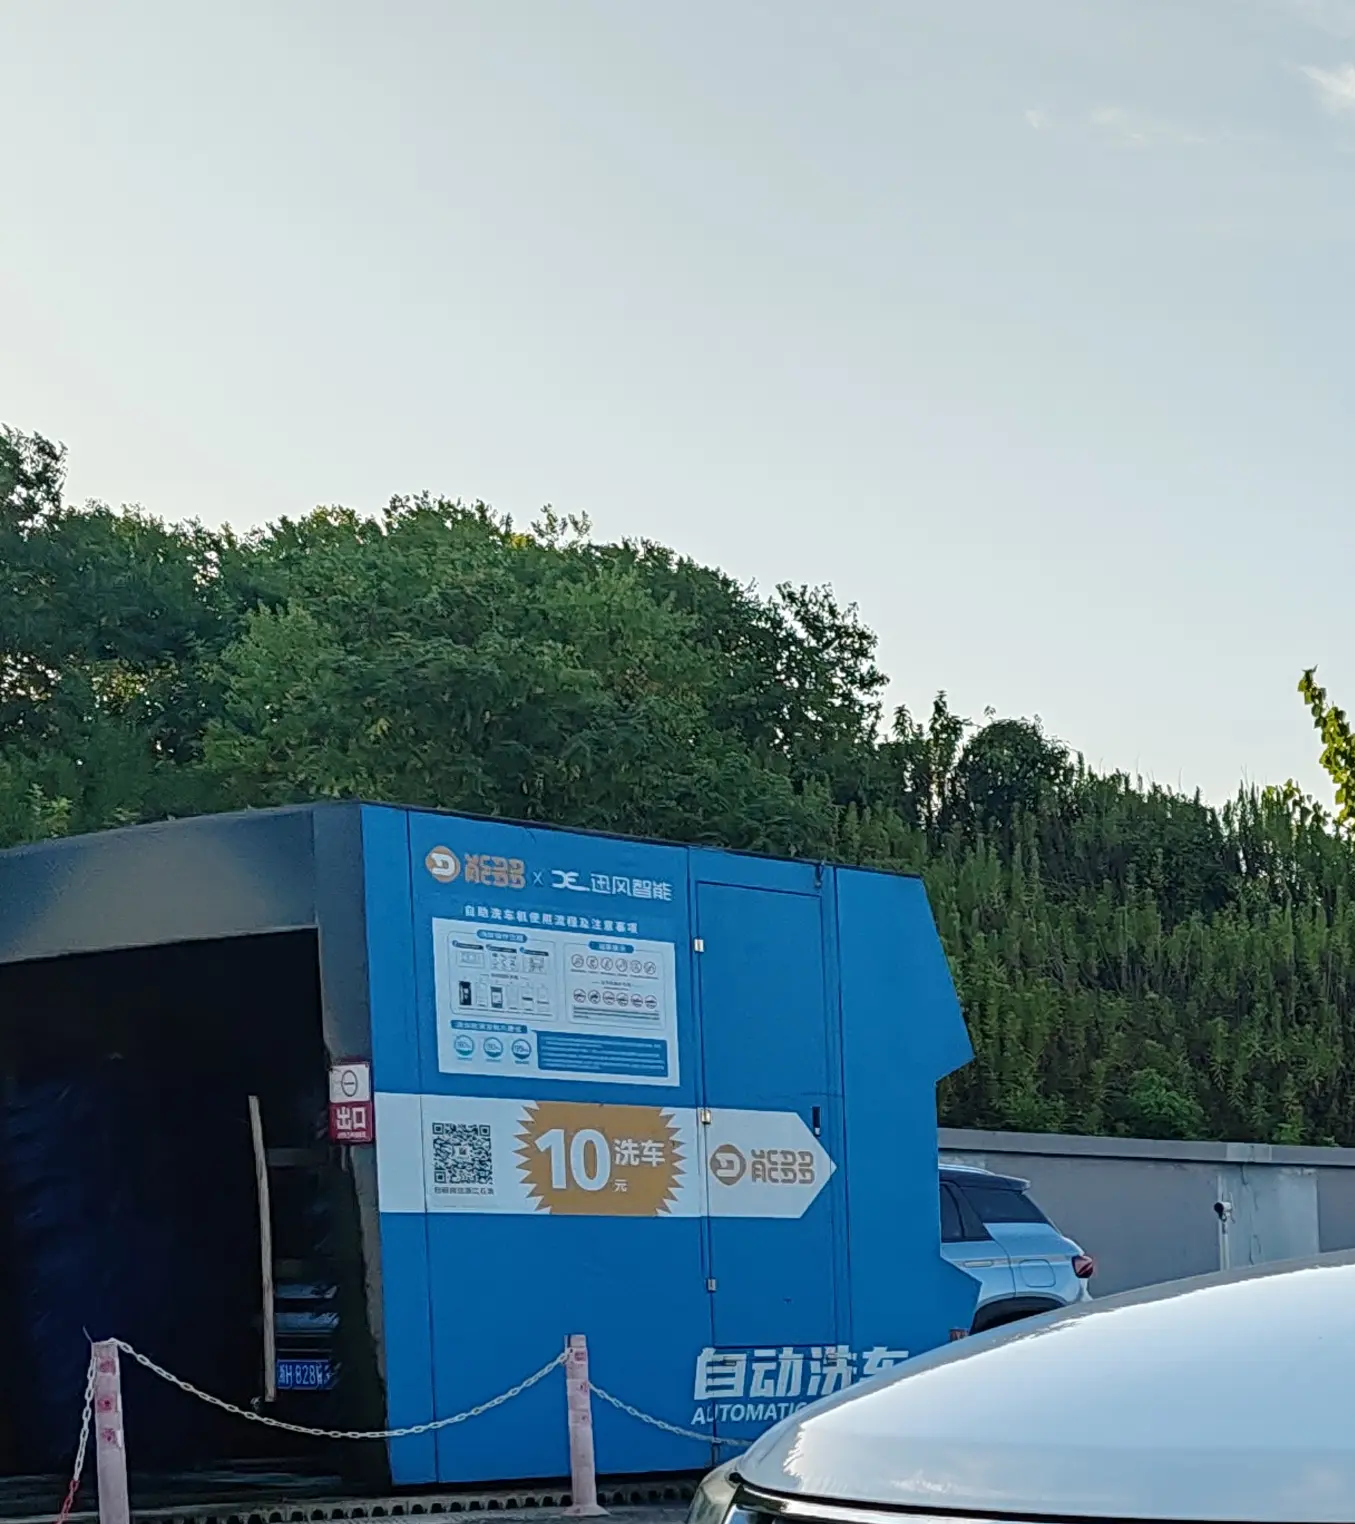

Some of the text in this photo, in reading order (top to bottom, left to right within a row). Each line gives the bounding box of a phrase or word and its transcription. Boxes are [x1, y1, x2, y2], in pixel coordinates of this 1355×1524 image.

[591, 874, 672, 900] 迅风智能
[336, 1105, 367, 1130] 出口
[535, 1128, 666, 1192] 10 洗车
[750, 1148, 816, 1185] 能多多
[614, 1179, 628, 1193] 元
